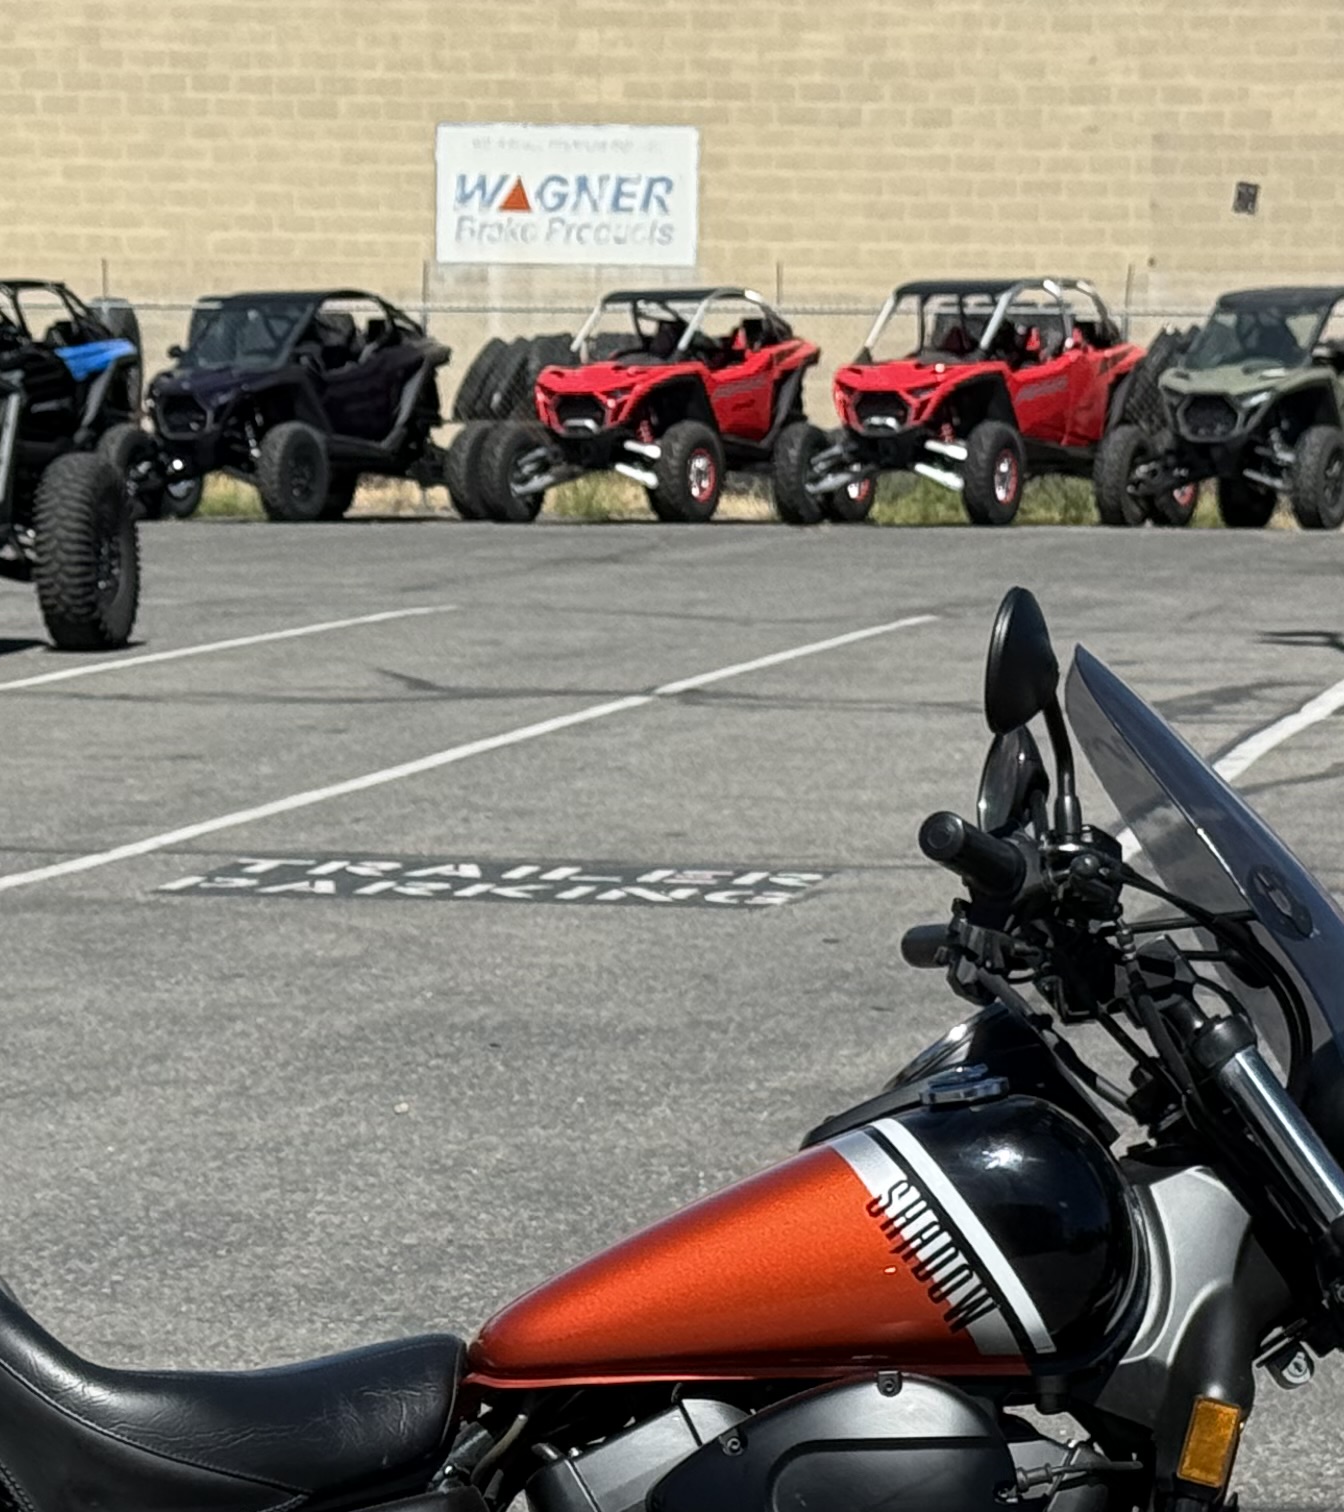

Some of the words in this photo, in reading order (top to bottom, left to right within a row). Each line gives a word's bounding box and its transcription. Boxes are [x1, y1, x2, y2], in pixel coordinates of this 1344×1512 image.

[454, 173, 675, 214] WAGNER
[238, 858, 824, 887] TRAILER
[158, 876, 799, 905] PARKING
[866, 1180, 1000, 1333] SHADOW
